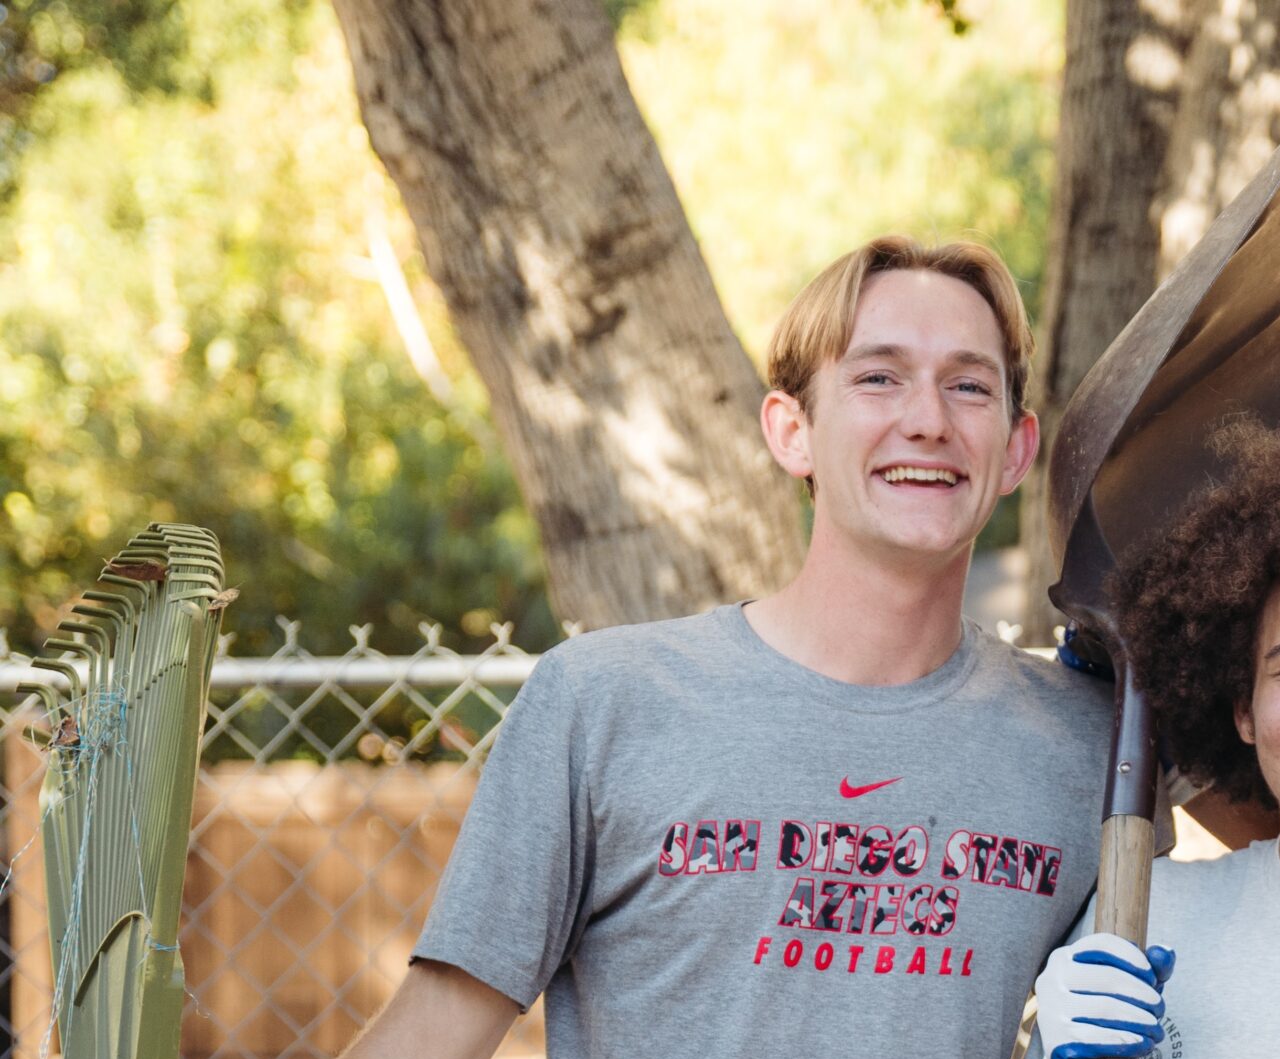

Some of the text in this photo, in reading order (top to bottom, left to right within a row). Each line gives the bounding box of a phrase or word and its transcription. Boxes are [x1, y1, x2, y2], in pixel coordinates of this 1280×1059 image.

[659, 819, 1062, 897] SAN DIEGO STATE
[777, 877, 960, 936] AZTECS
[752, 936, 974, 976] FOOTBALL
